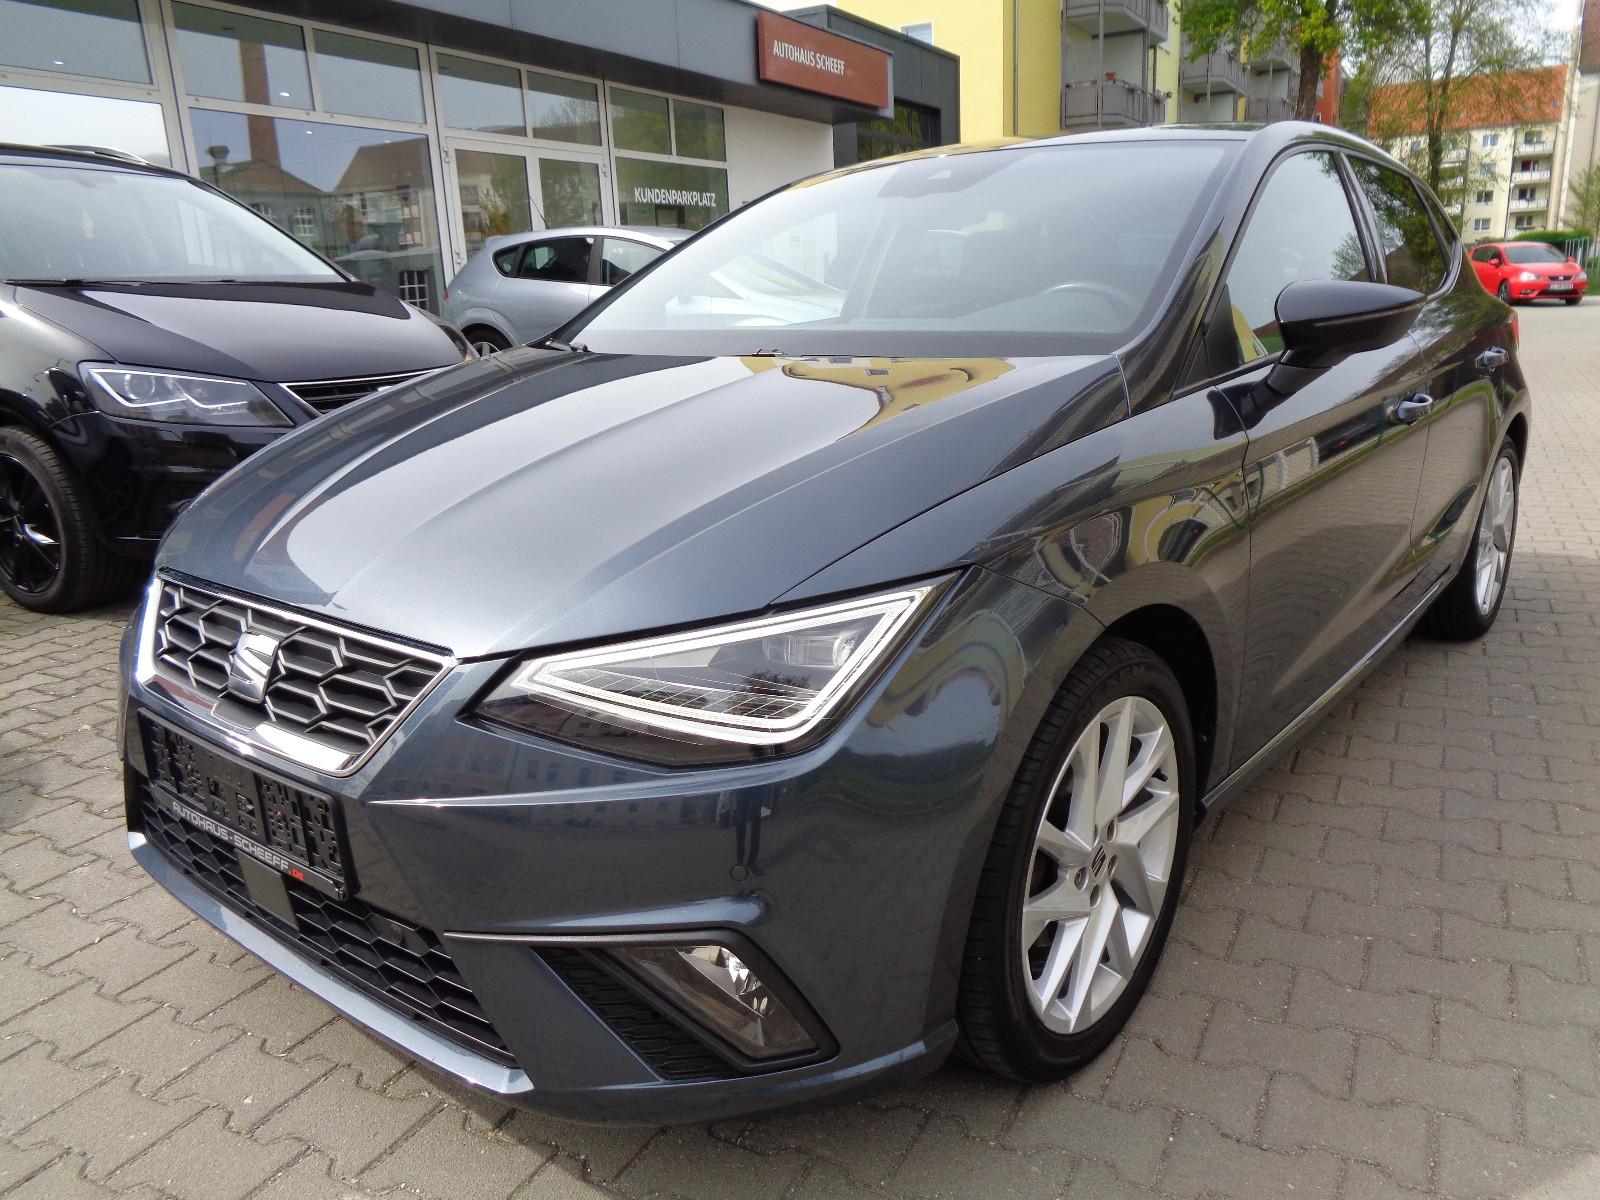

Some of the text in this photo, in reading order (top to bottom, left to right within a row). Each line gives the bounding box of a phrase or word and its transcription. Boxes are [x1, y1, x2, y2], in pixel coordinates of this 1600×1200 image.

[773, 39, 845, 76] AUTOHAUS SCHEEFF
[634, 186, 717, 207] KUNDENPARKPLATZ
